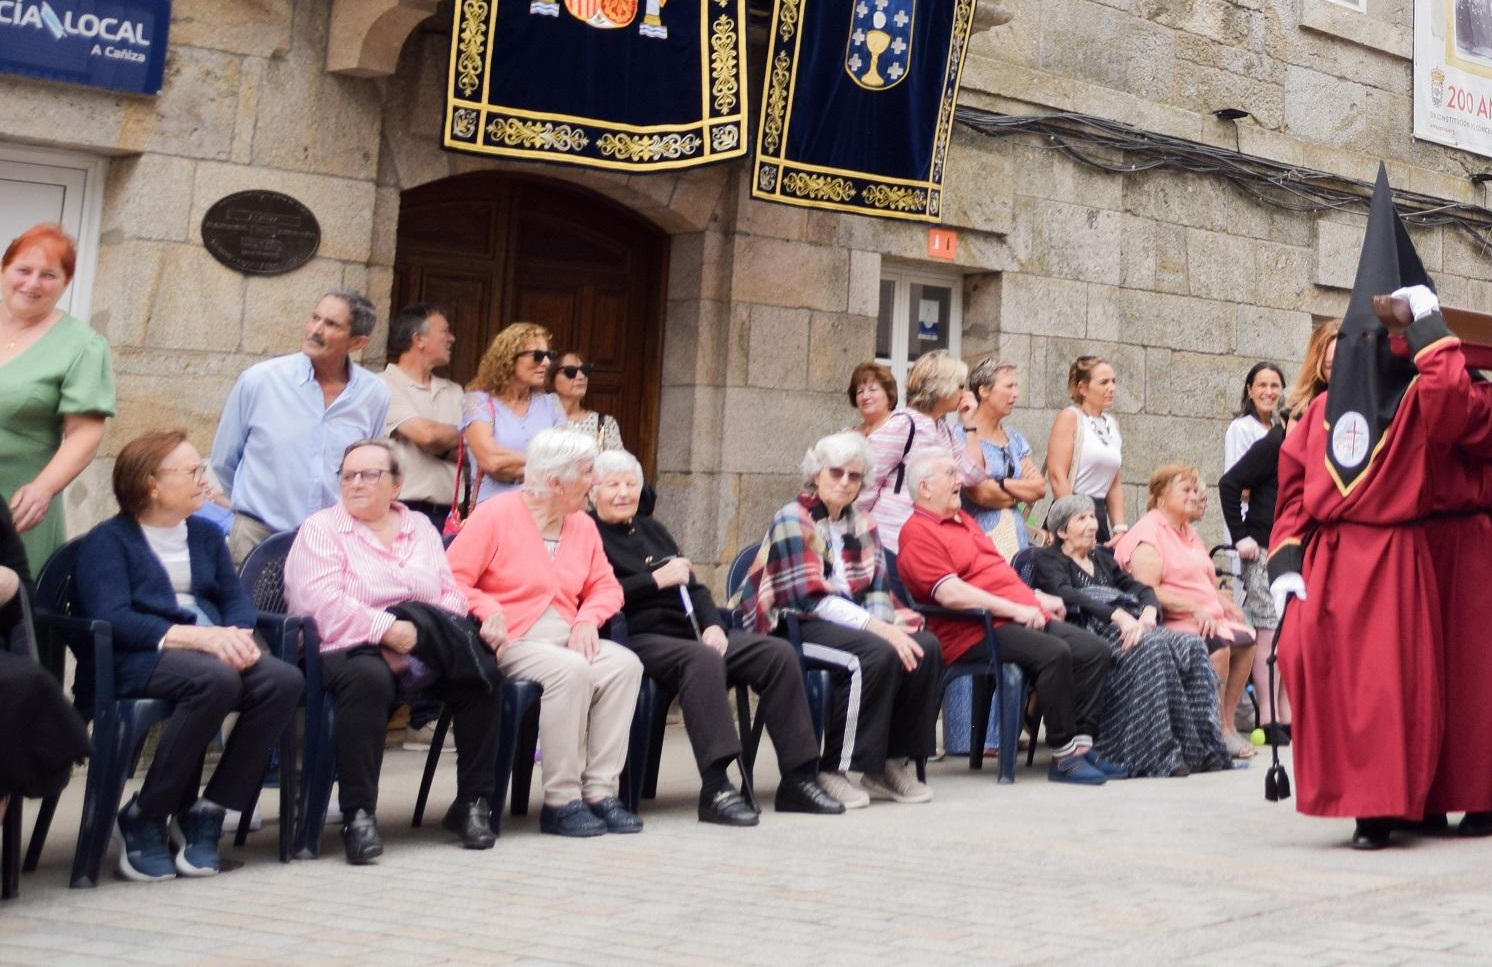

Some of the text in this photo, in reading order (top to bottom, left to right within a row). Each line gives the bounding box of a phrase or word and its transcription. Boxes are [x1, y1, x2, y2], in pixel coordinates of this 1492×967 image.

[64, 10, 151, 46] LOCAL
[90, 44, 146, 63] A Cañiza
[1446, 85, 1474, 114] 200
